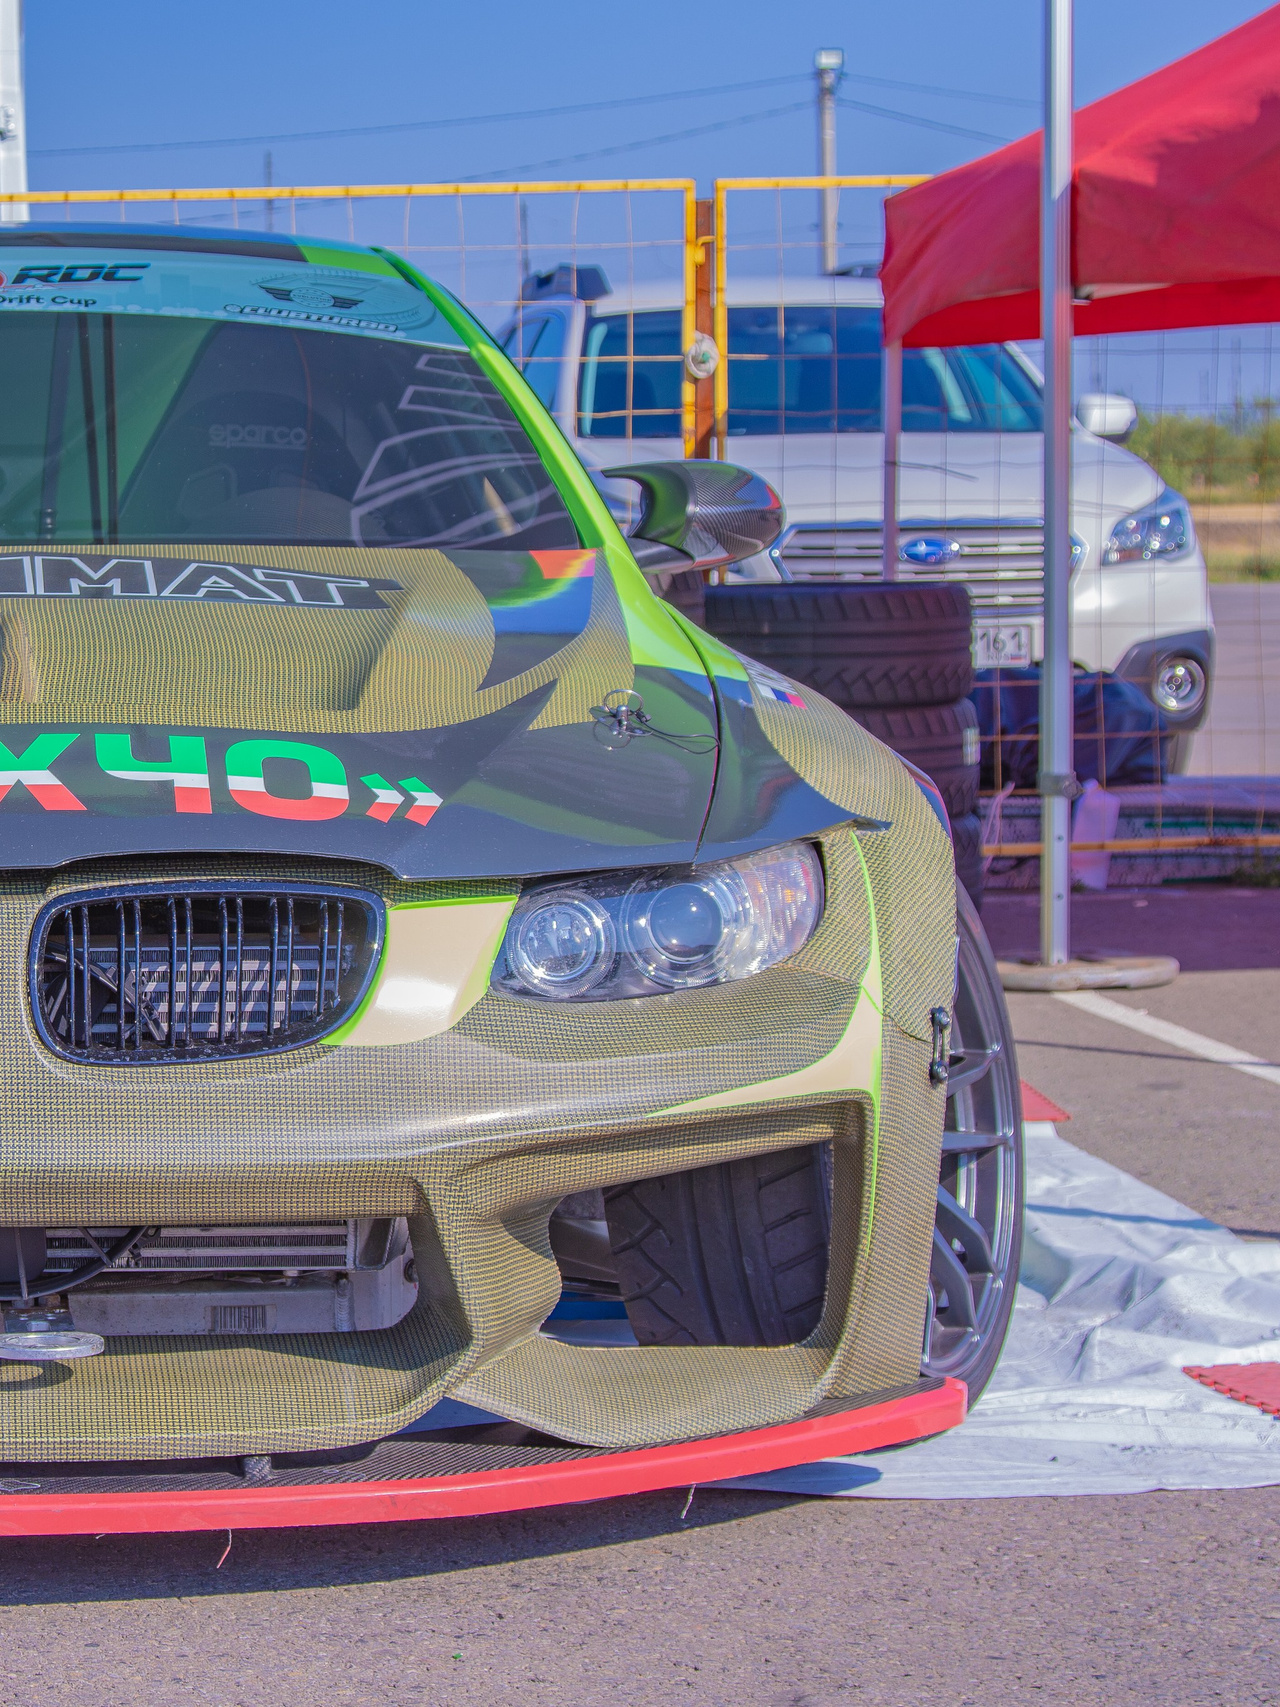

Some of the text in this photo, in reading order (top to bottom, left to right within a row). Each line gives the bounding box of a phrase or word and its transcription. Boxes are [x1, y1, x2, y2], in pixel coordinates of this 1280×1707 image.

[12, 262, 151, 285] RDC
[51, 295, 98, 308] Cup
[241, 304, 399, 333] CLUBTURBO
[208, 423, 307, 449] sparco
[979, 628, 1024, 653] 161
